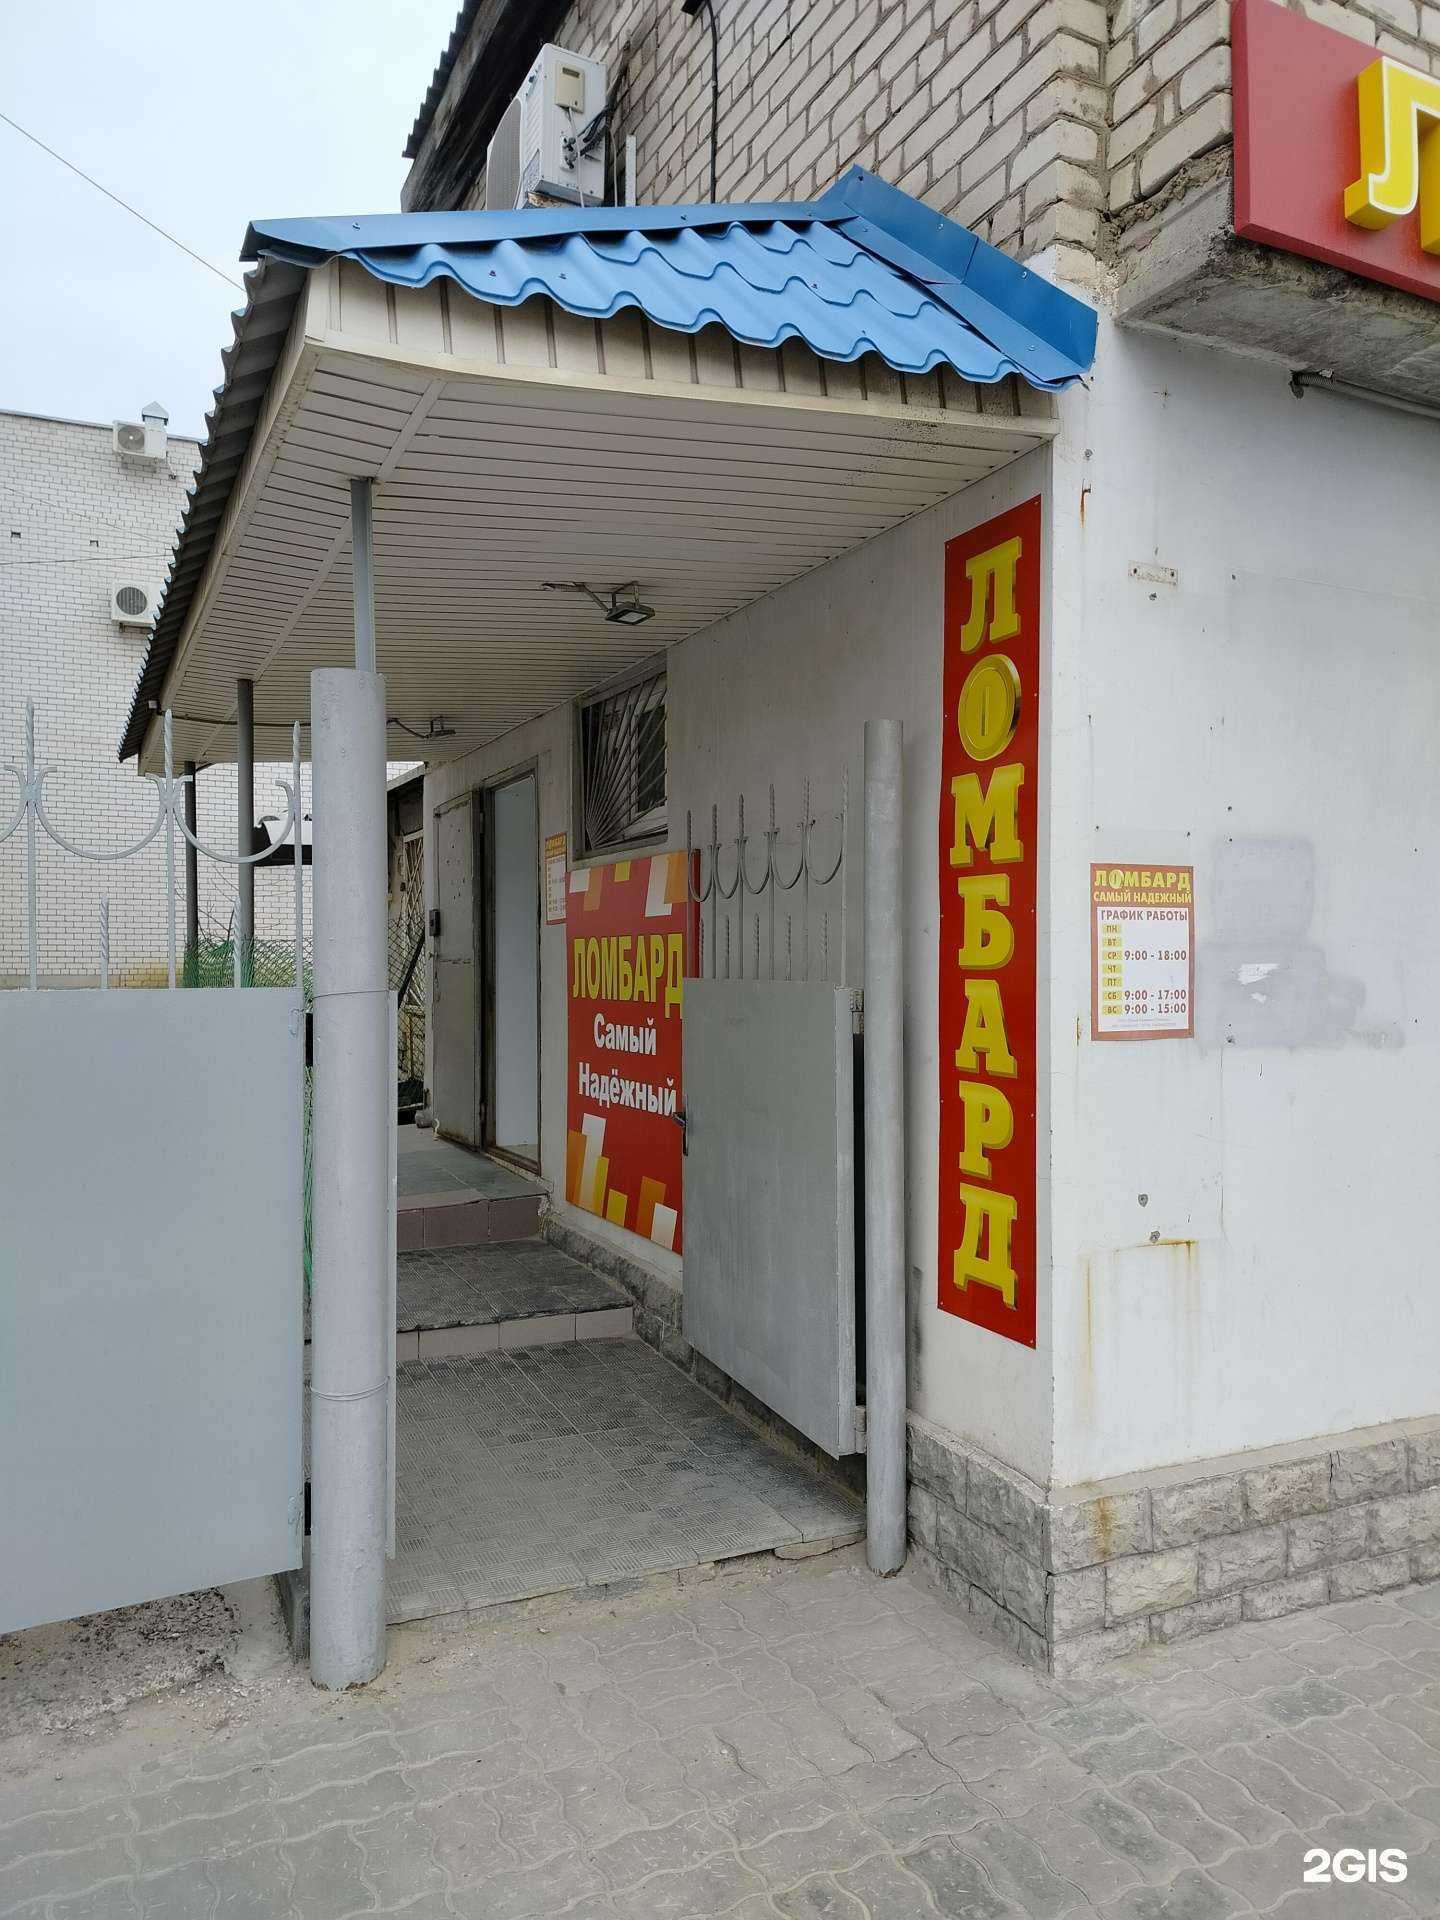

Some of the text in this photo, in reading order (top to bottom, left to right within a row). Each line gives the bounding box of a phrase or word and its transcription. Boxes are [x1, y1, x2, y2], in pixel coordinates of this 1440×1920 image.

[1095, 869, 1191, 891] ЛОМБАРД
[1094, 889, 1192, 904] САМЫЙ НАДЕЖНЫЙ
[1101, 910, 1187, 921] ГРАФИК РАБОТЫ
[950, 535, 1024, 1311] ЛОМБАРД
[1106, 925, 1118, 933] ПН
[1107, 938, 1117, 946] ВТ
[1107, 952, 1117, 960] СР
[1124, 950, 1148, 960] 9:00
[1158, 950, 1187, 960] 18:00
[1107, 965, 1117, 973] ЧТ
[572, 933, 683, 1018] ЛОМБАРД
[1107, 978, 1117, 986] ПТ
[1107, 991, 1117, 999] СБ
[1124, 990, 1148, 1000] 9:00
[1158, 990, 1187, 1000] 17:00
[1107, 1006, 1117, 1014] ВС
[1124, 1004, 1148, 1014] 9:00
[1158, 1003, 1187, 1014] 15:00
[593, 1012, 657, 1056] Самый
[578, 1062, 676, 1117] Надёжный
